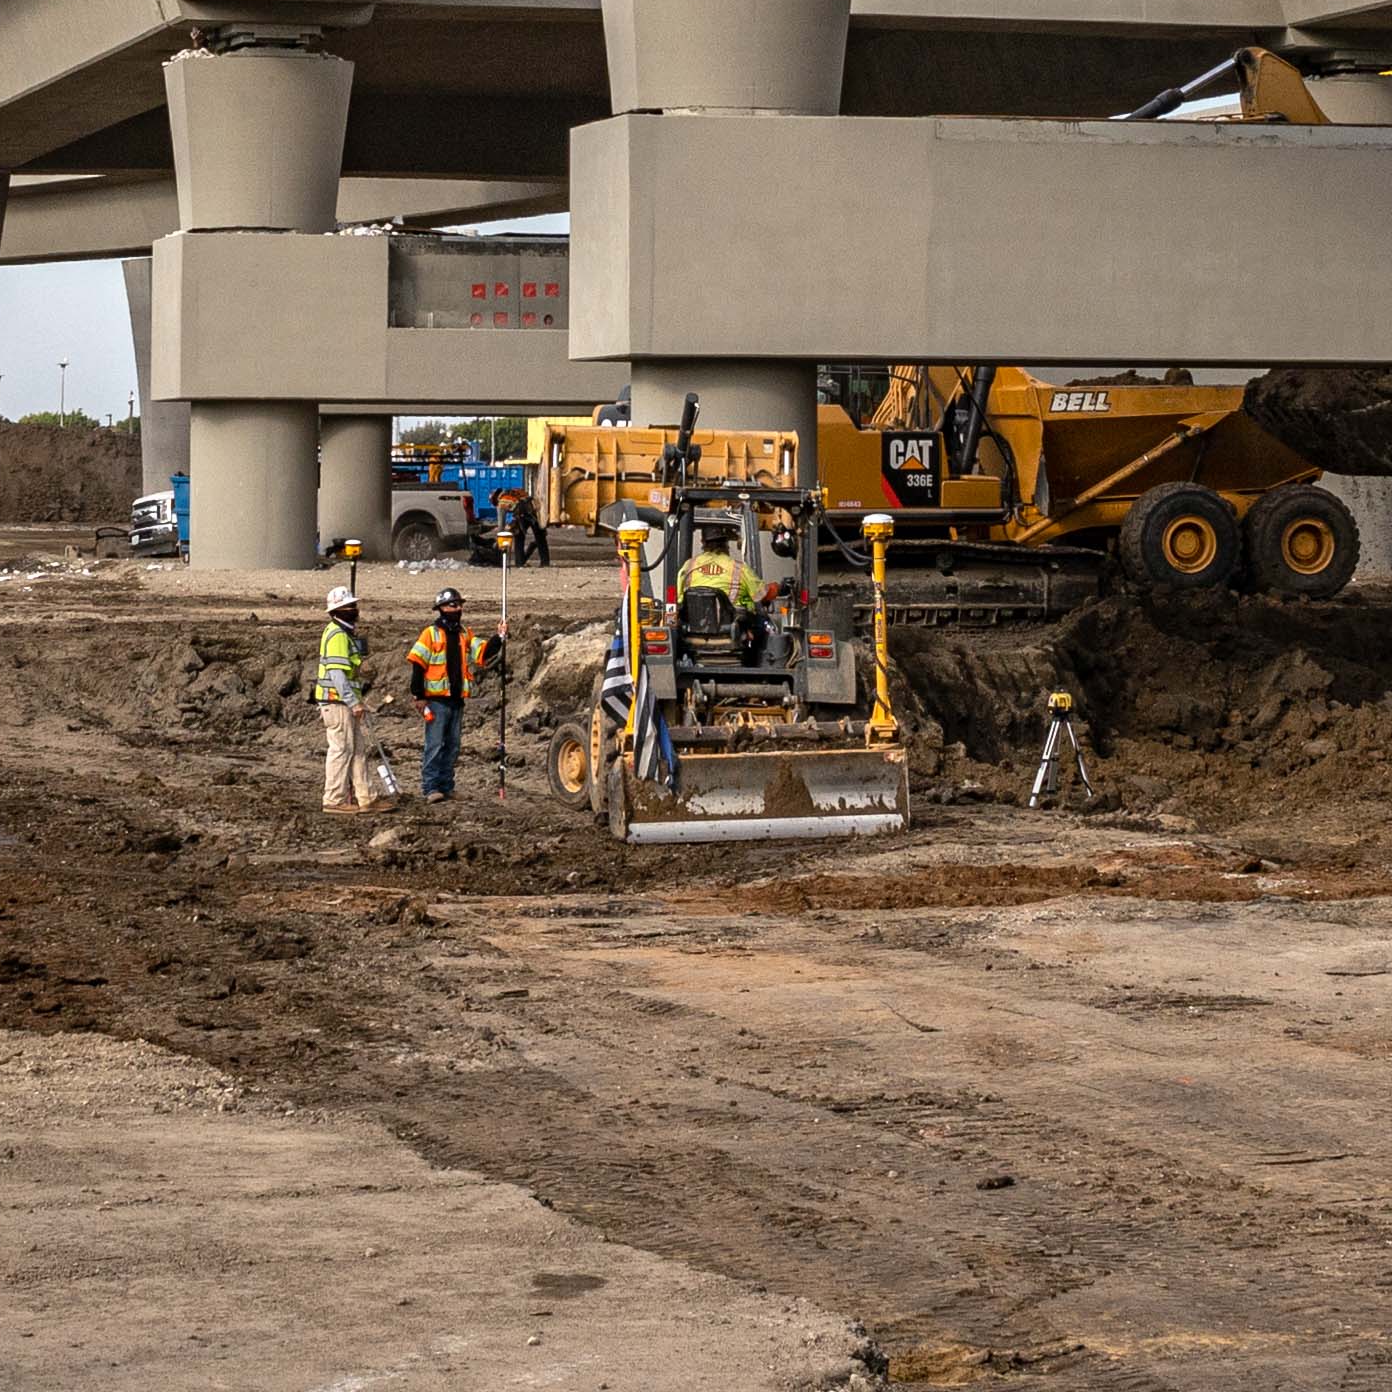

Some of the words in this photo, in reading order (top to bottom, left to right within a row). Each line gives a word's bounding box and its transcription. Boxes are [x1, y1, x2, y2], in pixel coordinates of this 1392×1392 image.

[1051, 392, 1111, 412] BELL
[889, 439, 933, 470] CAT
[907, 474, 934, 487] 336E
